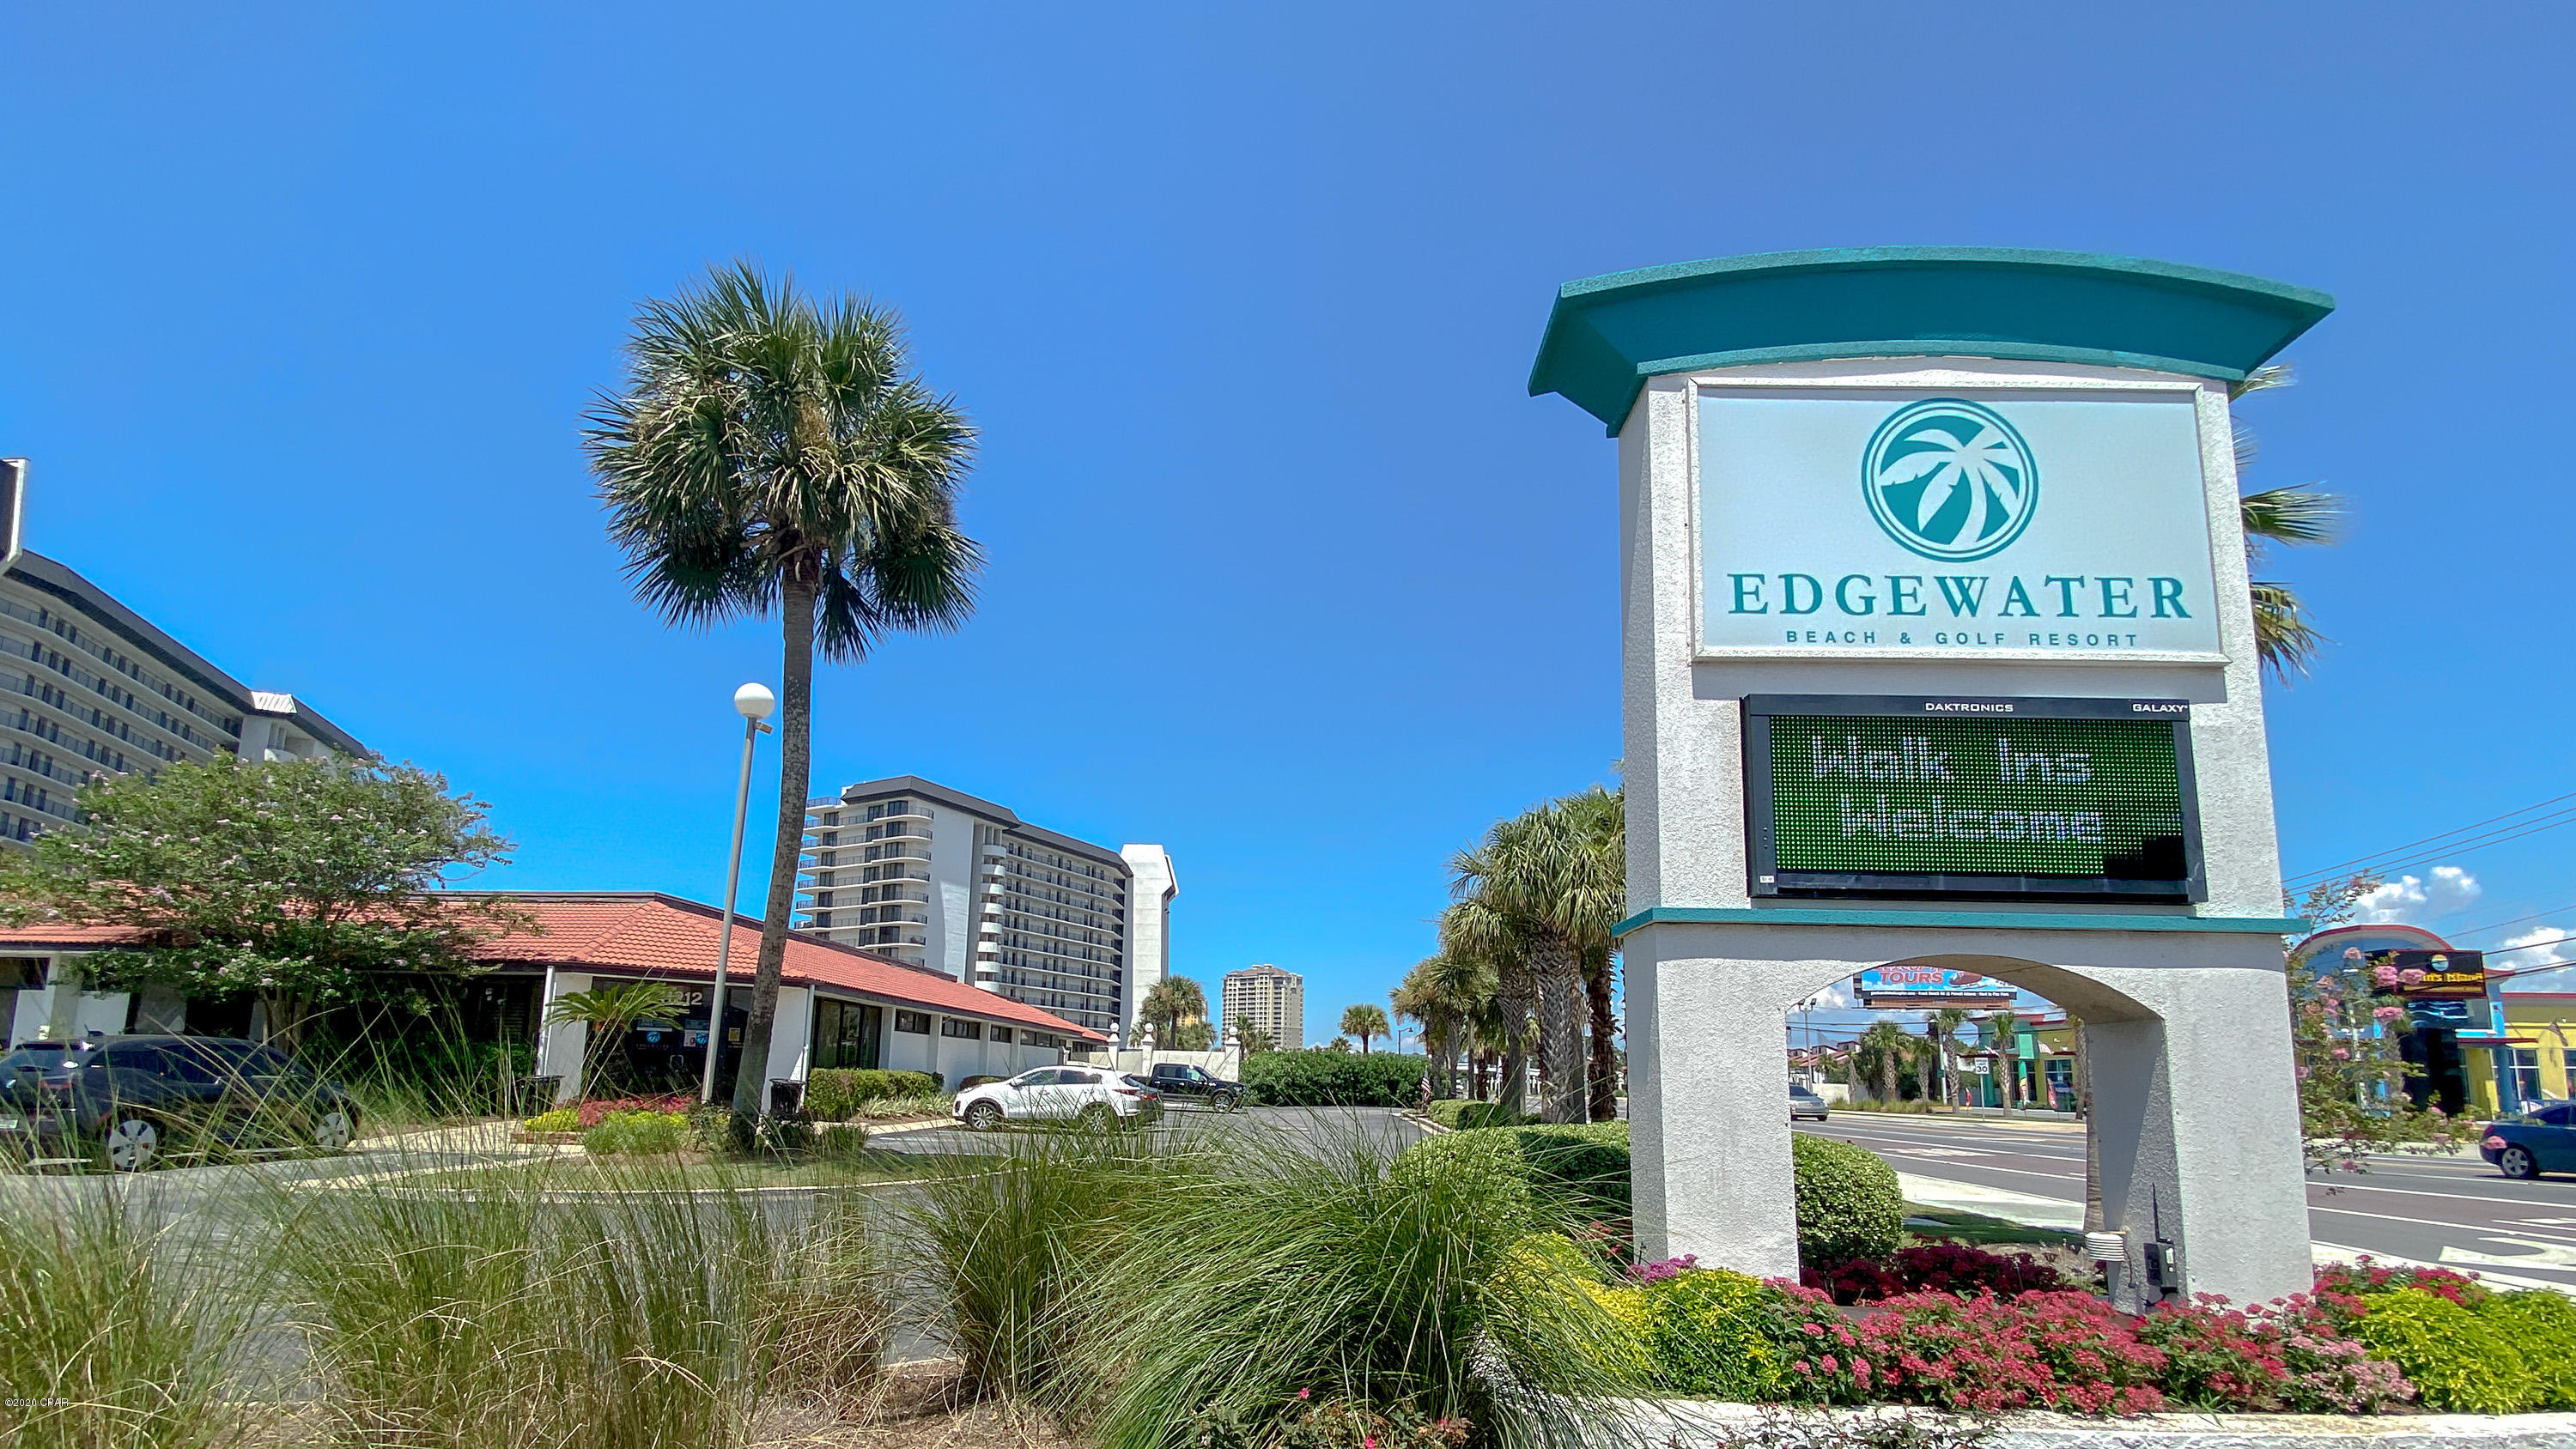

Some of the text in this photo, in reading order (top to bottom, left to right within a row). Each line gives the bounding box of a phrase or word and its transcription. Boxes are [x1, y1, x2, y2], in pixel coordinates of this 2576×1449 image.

[1727, 573, 2193, 619] EDGEWATER
[1786, 631, 2137, 646] BEACH & GOLF RESORT
[1924, 702, 2014, 713] DAKTRONICS
[1812, 734, 2093, 785] Walk Ins
[1840, 792, 2104, 845] Welcome
[1879, 971, 1944, 985] TOURS
